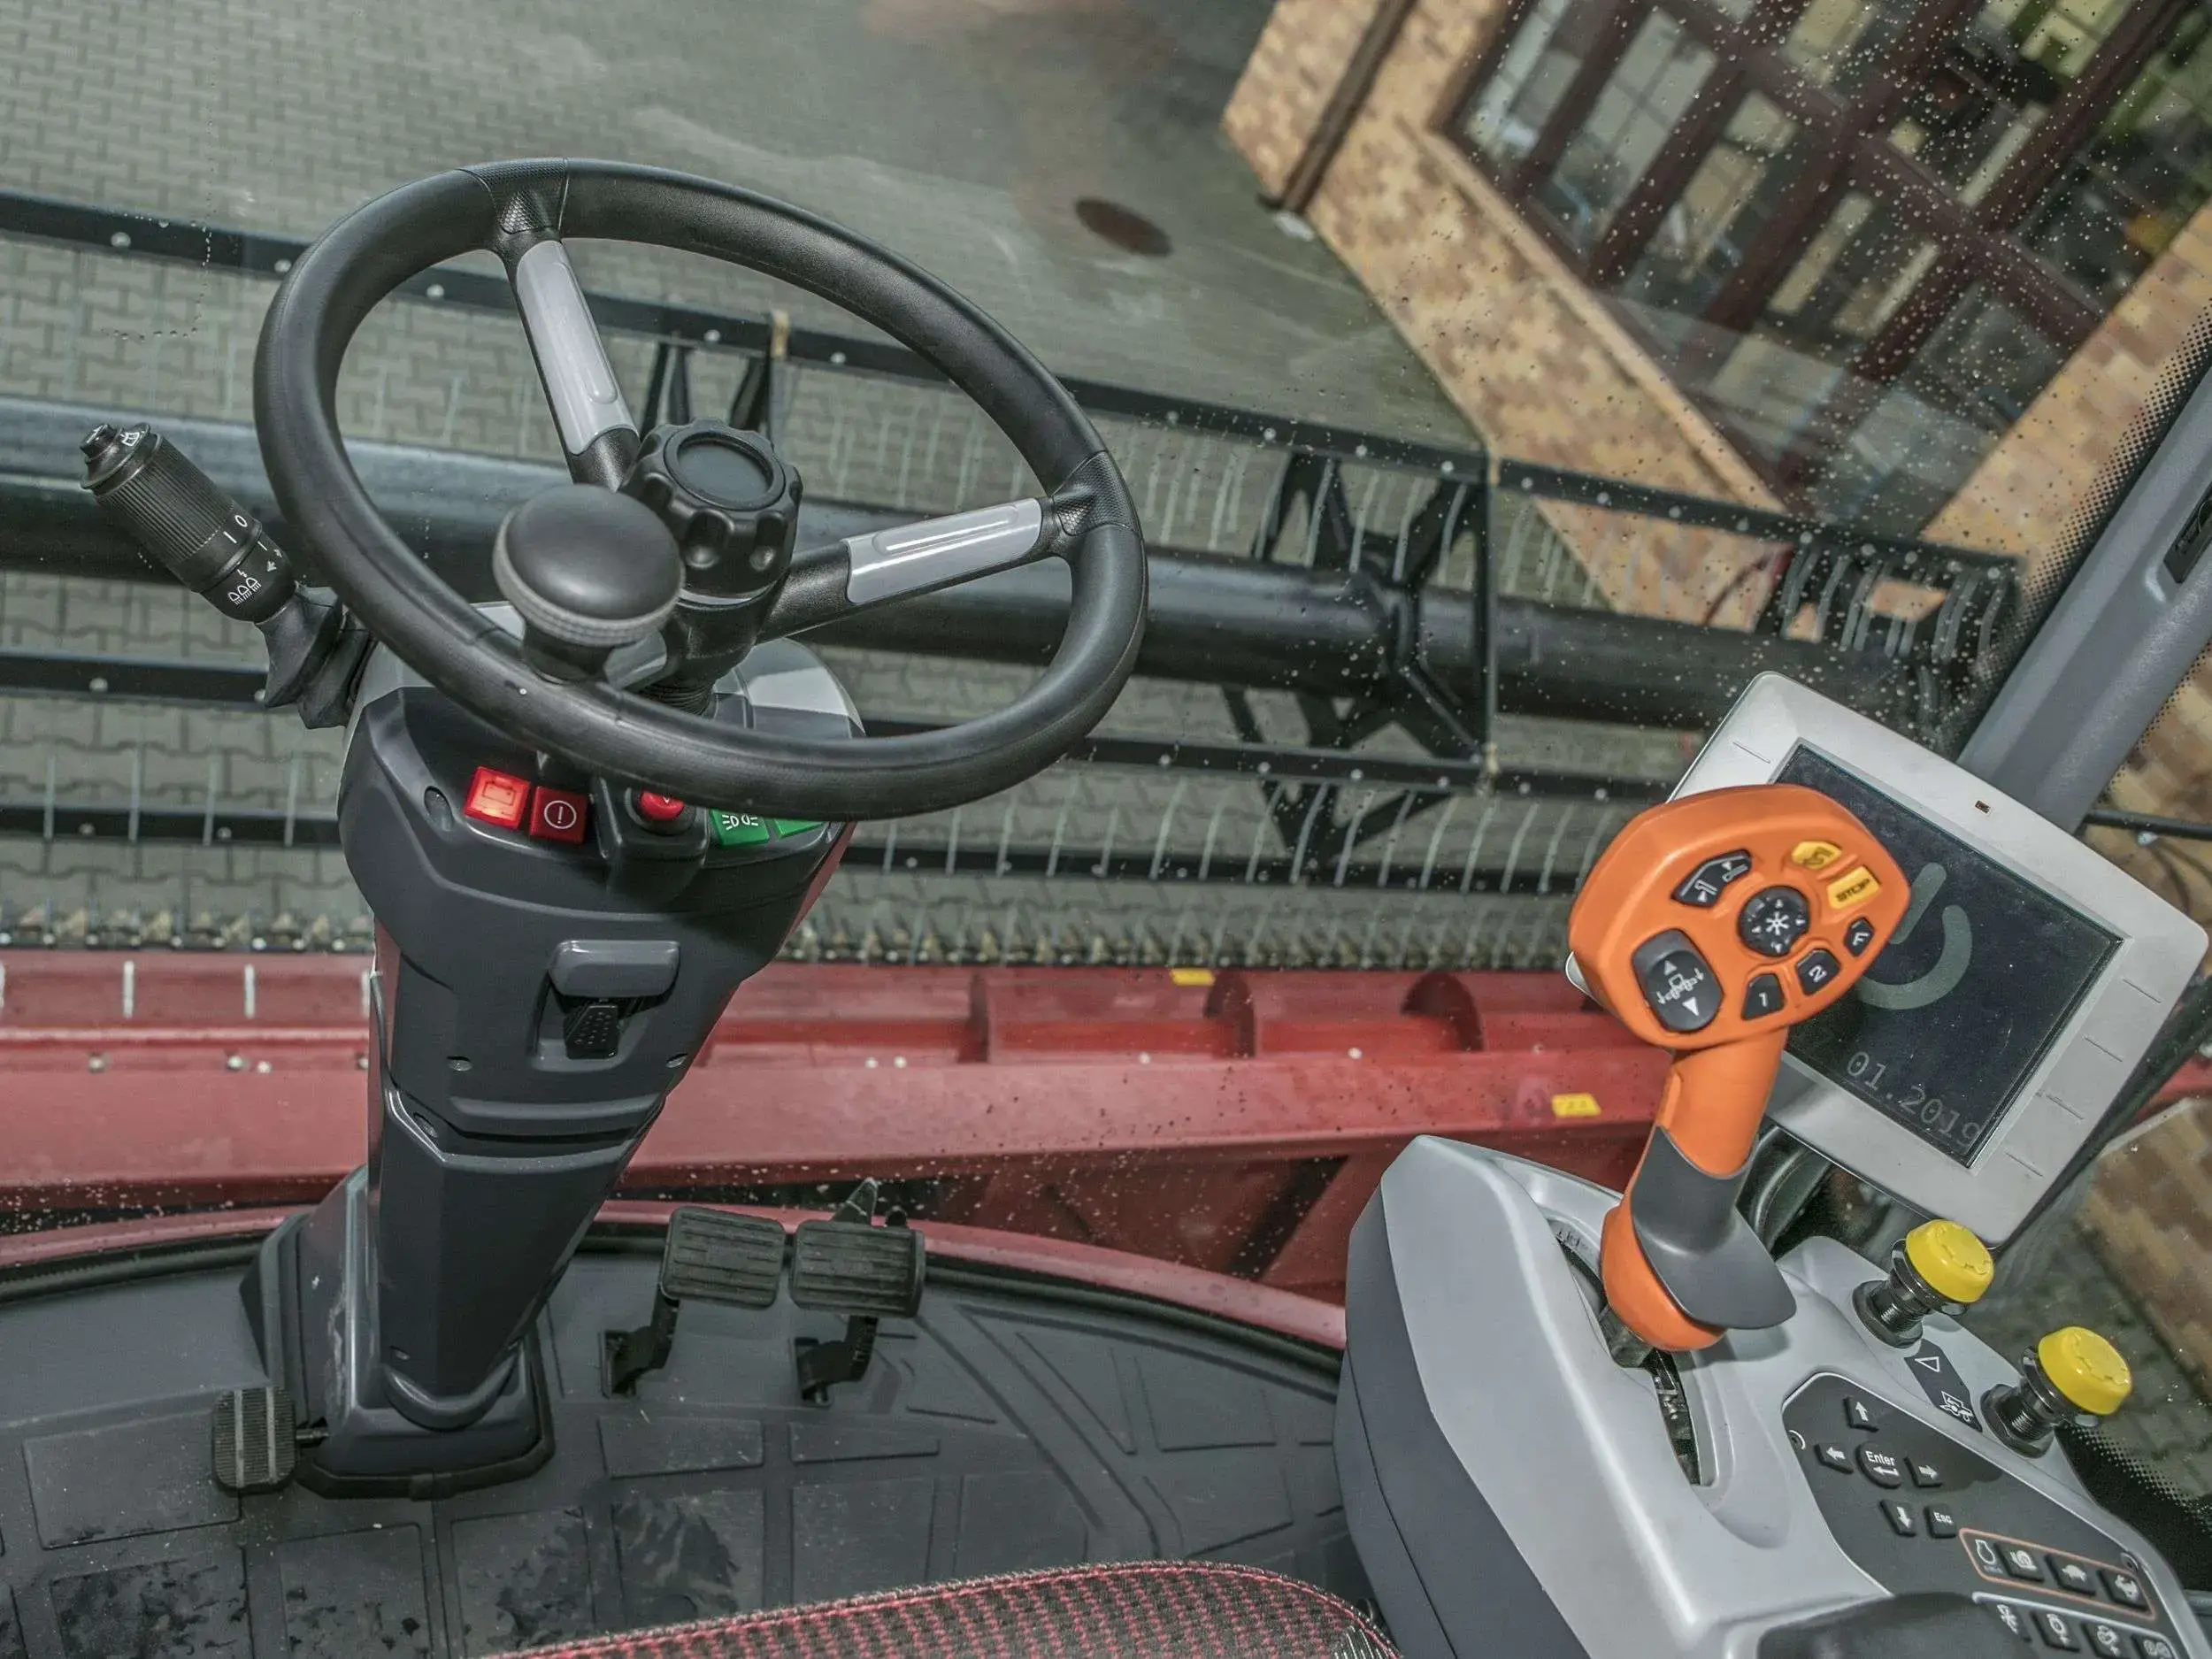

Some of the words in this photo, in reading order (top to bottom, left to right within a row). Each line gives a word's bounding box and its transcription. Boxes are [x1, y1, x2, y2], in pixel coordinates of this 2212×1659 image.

[1835, 878, 1870, 902] STOP
[1853, 932, 1870, 947] F
[1809, 965, 1827, 983] 2
[1758, 992, 1768, 1008] 1
[1847, 1051, 1983, 1148] 01.2019
[1865, 1450, 1896, 1467] Enter
[1933, 1511, 1954, 1526] Esc
